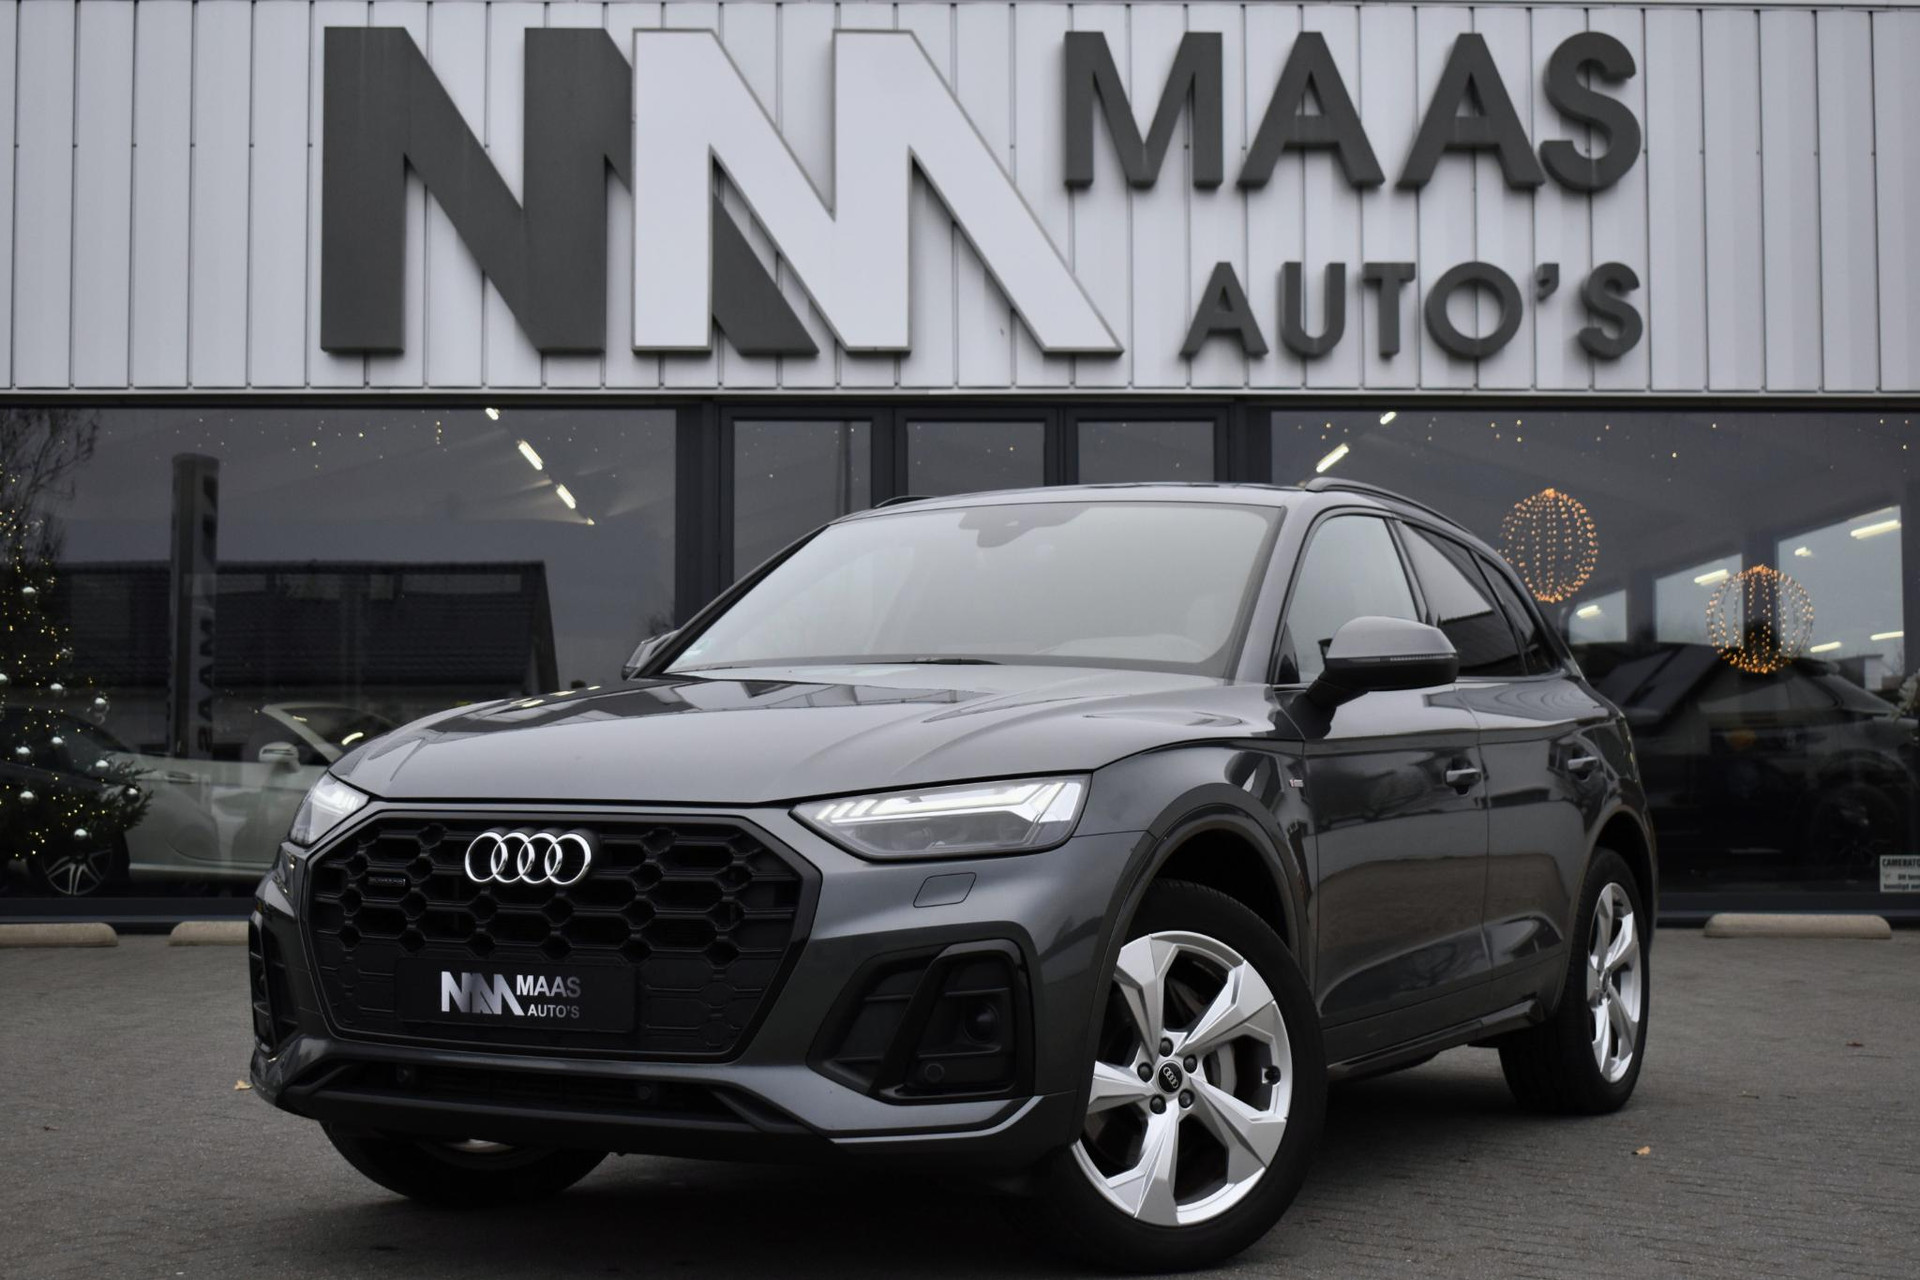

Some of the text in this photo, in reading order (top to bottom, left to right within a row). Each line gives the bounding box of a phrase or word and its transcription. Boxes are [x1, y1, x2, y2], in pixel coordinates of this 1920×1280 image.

[1064, 31, 1641, 192] MAAS
[1179, 261, 1644, 361] AUTO'S
[516, 974, 581, 998] MAAS
[527, 1003, 580, 1019] AUTO'S
